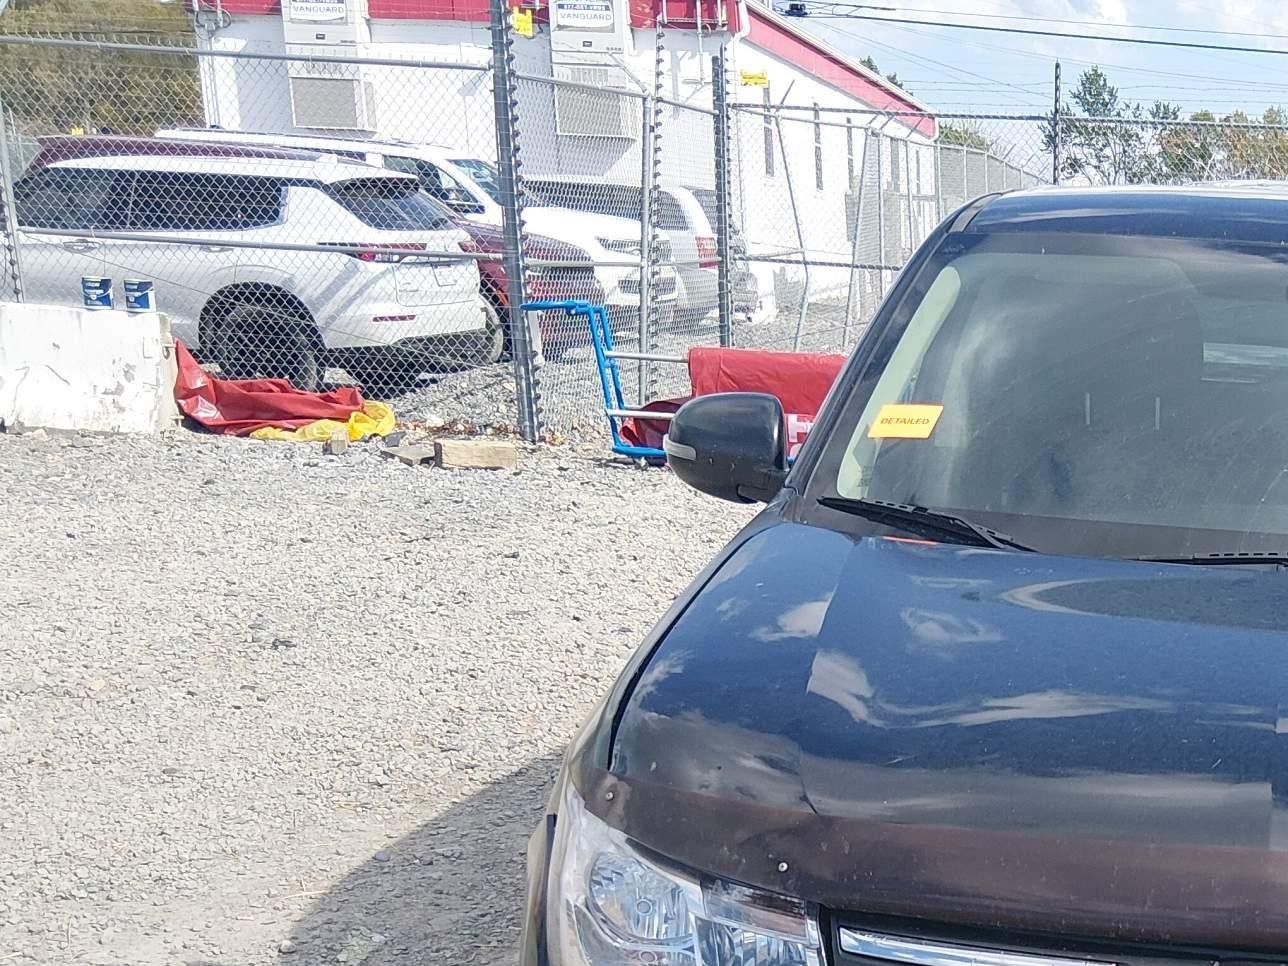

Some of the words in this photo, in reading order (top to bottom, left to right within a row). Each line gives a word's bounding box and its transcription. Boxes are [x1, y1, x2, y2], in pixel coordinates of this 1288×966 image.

[292, 5, 345, 14] VANGUARD
[560, 12, 612, 21] VANGUARD
[880, 417, 930, 425] DETAILED
